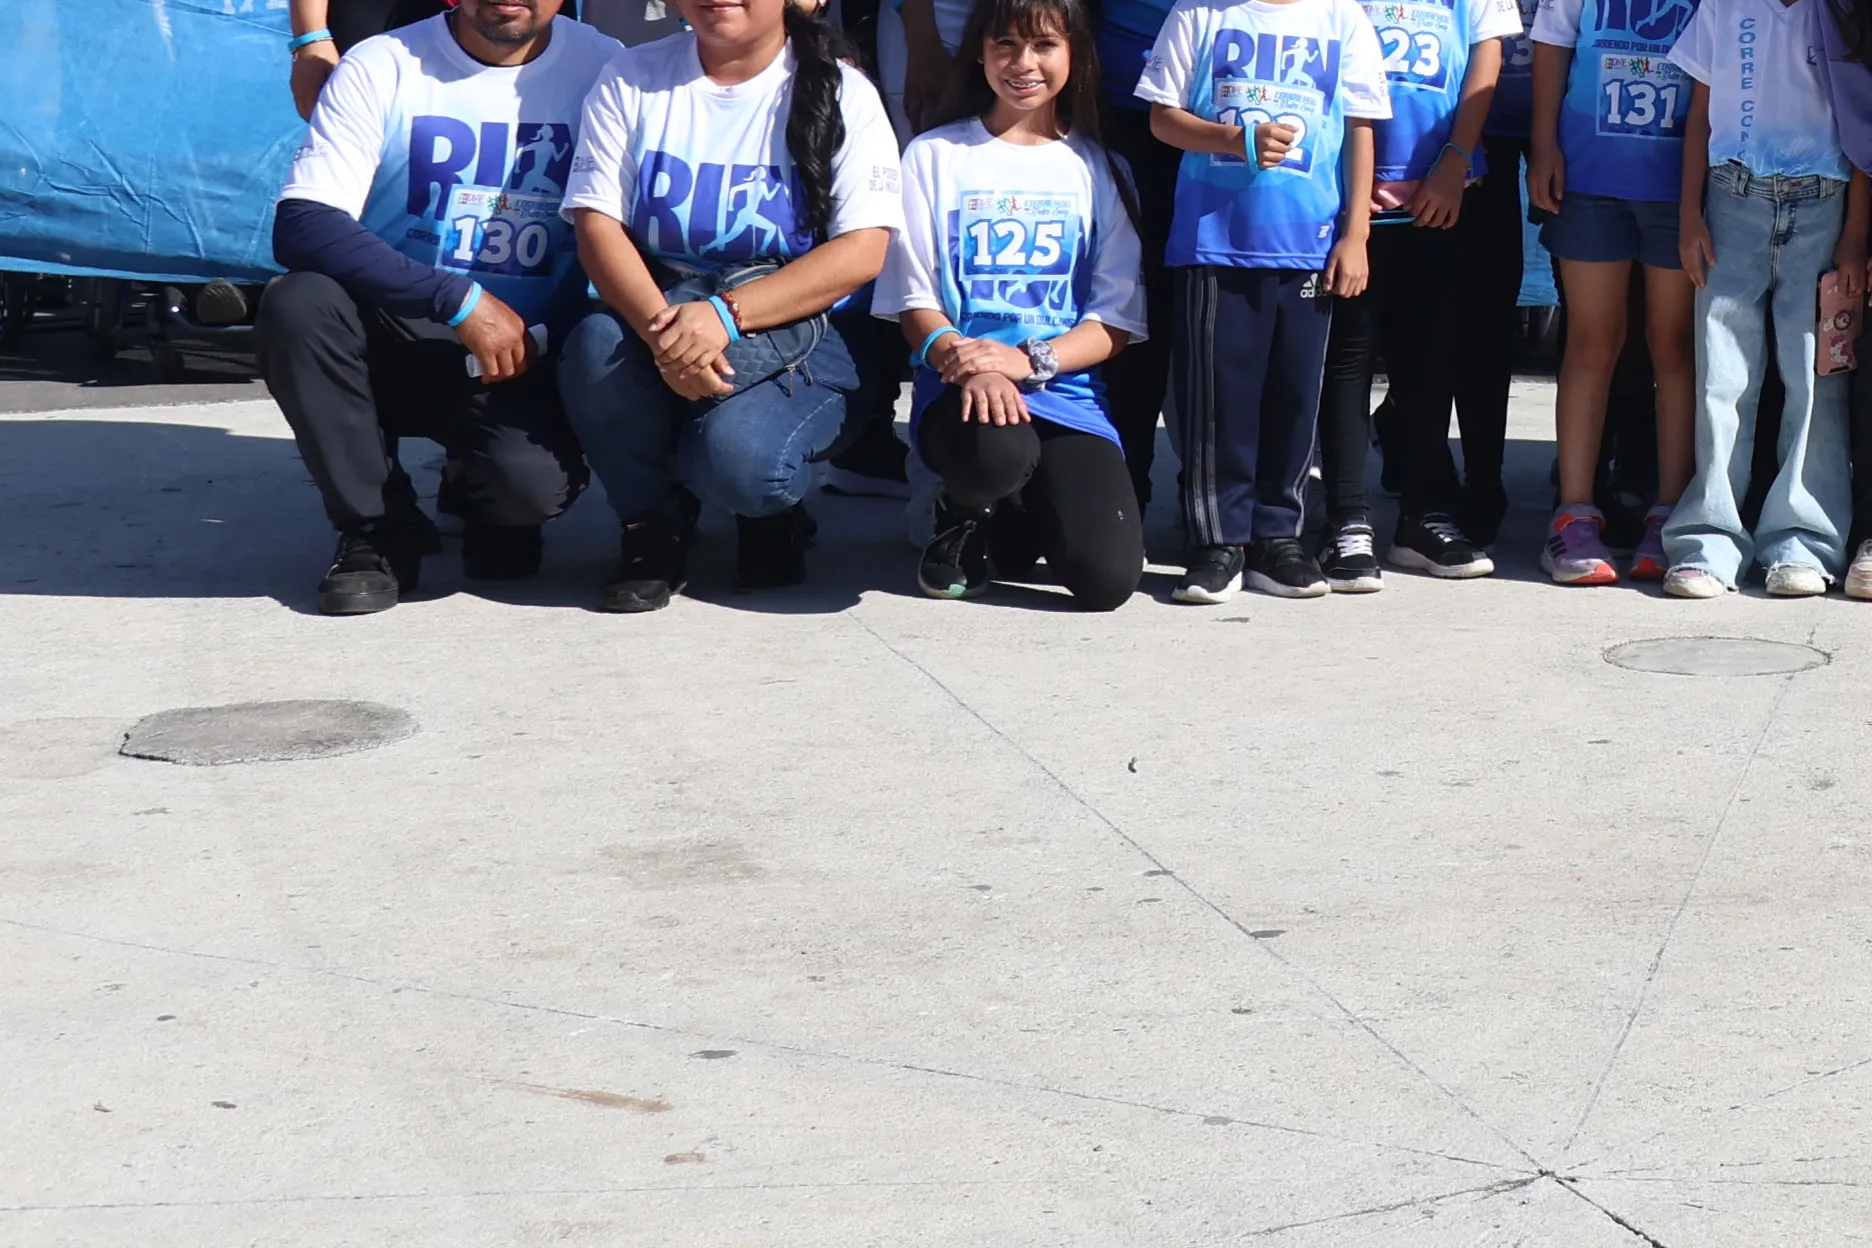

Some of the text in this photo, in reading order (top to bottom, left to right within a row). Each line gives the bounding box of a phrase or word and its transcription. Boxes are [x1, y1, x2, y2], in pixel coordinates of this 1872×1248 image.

[1376, 25, 1443, 77] 23
[1738, 18, 1756, 90] CORRE
[1603, 78, 1680, 129] 131
[452, 214, 550, 269] 130
[966, 218, 1066, 268] 125
